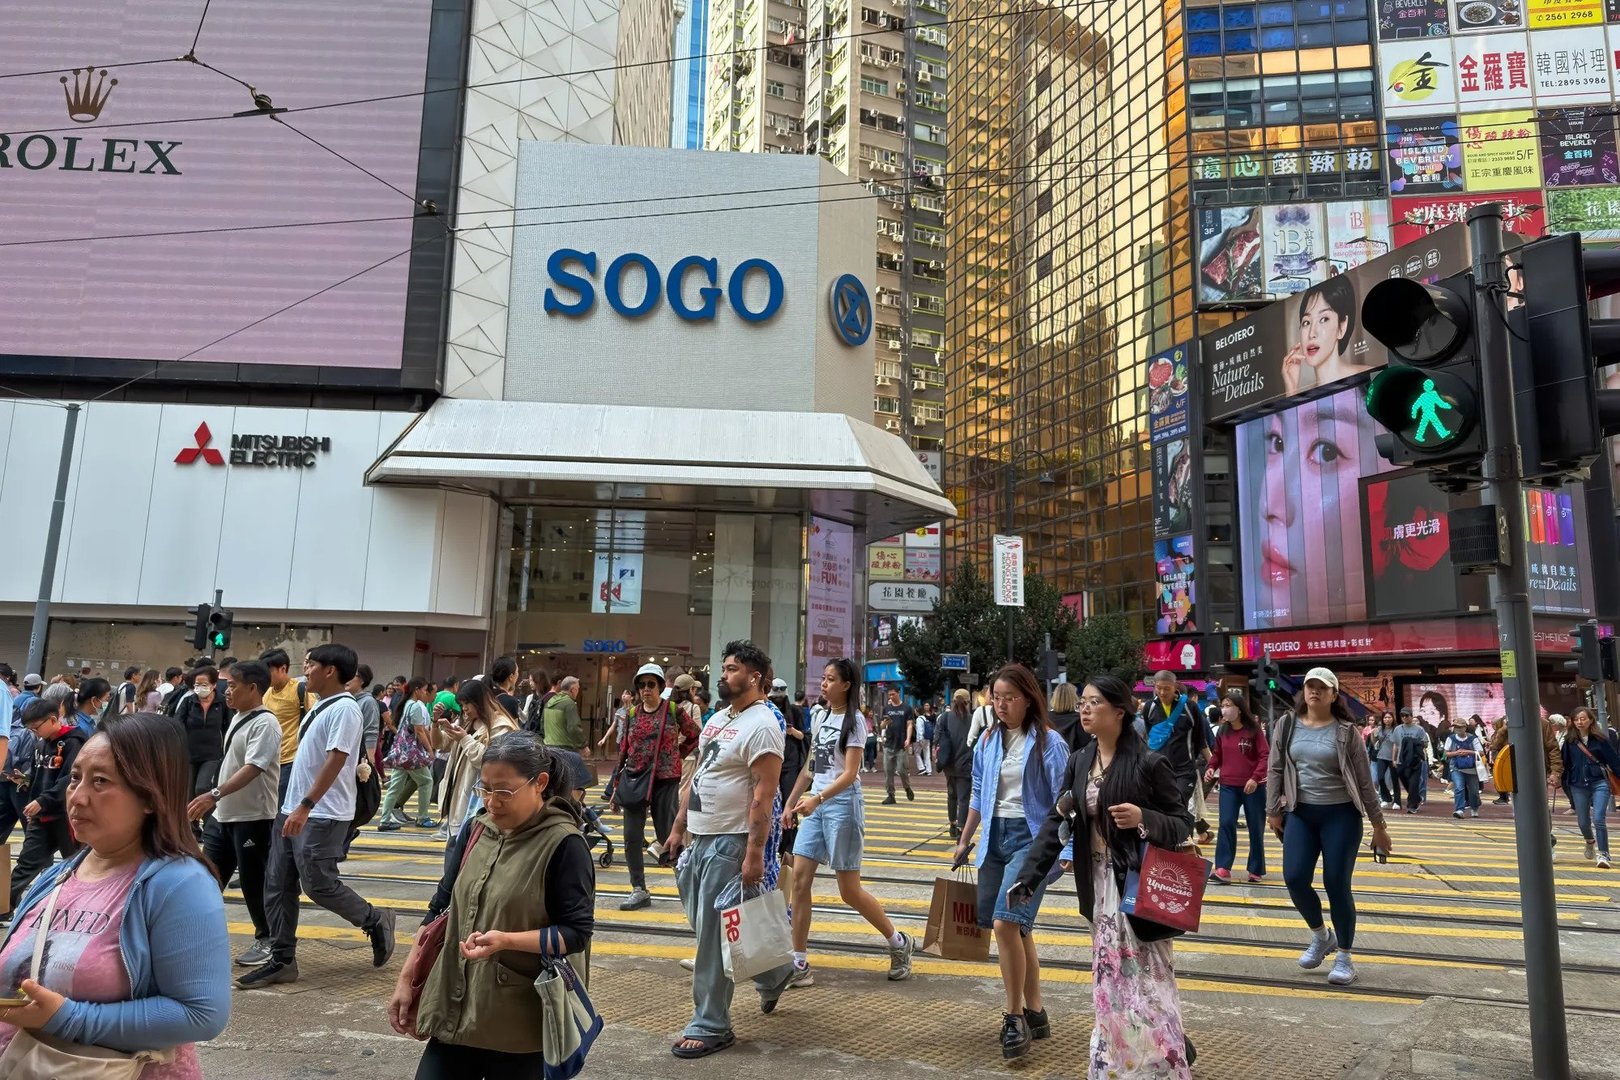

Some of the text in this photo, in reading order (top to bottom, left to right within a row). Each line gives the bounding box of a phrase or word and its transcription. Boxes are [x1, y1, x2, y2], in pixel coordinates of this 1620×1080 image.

[1545, 11, 1593, 21] 2561 2968
[1536, 48, 1607, 76] 韓國料理
[1459, 51, 1528, 92] 金羅寶
[1541, 77, 1606, 88] TEL:2895 3986
[1403, 146, 1444, 155] ISLAND
[1559, 139, 1597, 147] BEVERLEY
[1396, 154, 1453, 164] BEVERLEY
[1516, 148, 1534, 161] 5/F
[1564, 149, 1592, 160] 金百利
[1195, 147, 1372, 180] 傷心酸辣粉
[1471, 165, 1534, 178] 正宗重慶風味
[1204, 227, 1215, 235] 3F
[543, 248, 785, 322] SOGO
[1215, 325, 1255, 351] BELOTERO
[1212, 364, 1250, 390] Nature
[1225, 372, 1264, 402] Details
[230, 433, 331, 452] MITSUBISHI
[229, 449, 317, 467] ELECTRIC
[1393, 518, 1440, 540] 膚更光滑
[876, 550, 897, 561] 傷心
[871, 560, 902, 570] 酸辣粉
[821, 570, 838, 587] FUN
[1163, 572, 1186, 581] ISLAND
[1146, 877, 1193, 898] Uppacase
[953, 901, 976, 924] MU
